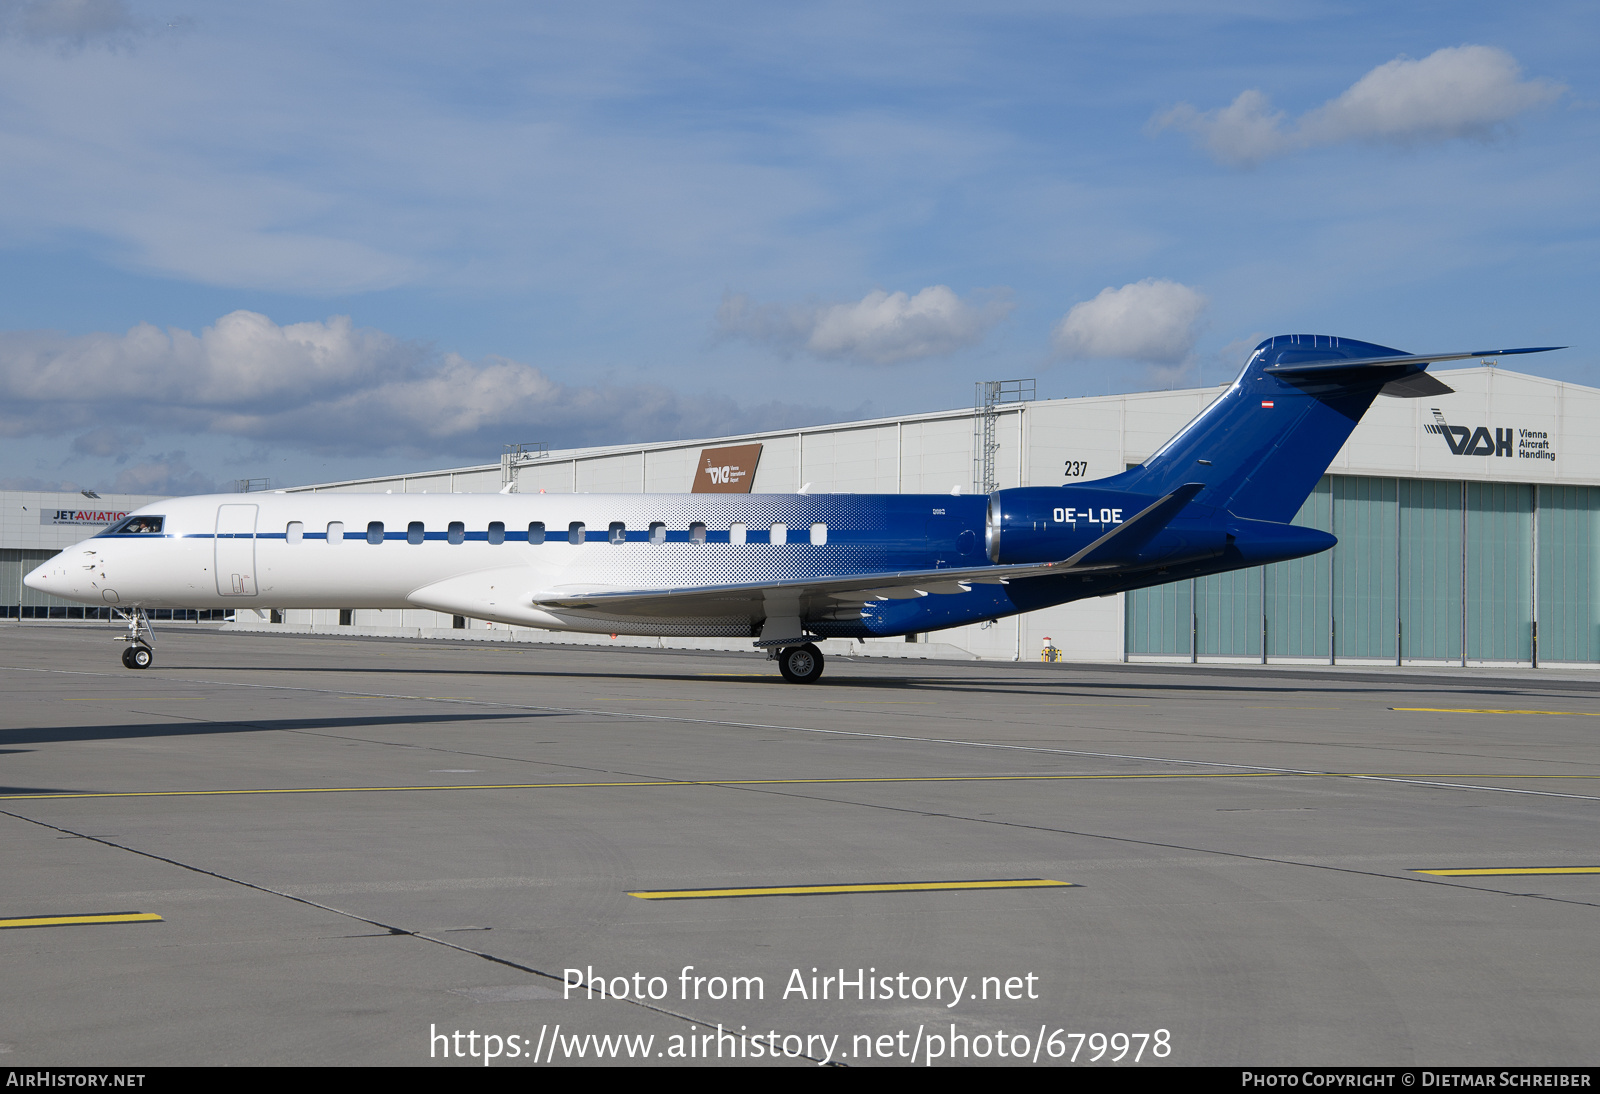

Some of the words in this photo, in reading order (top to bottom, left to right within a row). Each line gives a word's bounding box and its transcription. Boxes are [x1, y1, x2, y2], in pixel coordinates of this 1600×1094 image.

[1518, 428, 1548, 439] Vienna
[1518, 439, 1550, 450] Aircraft
[1518, 450, 1556, 462] Handling
[1064, 460, 1088, 477] 237
[1053, 507, 1123, 524] OE-LOE
